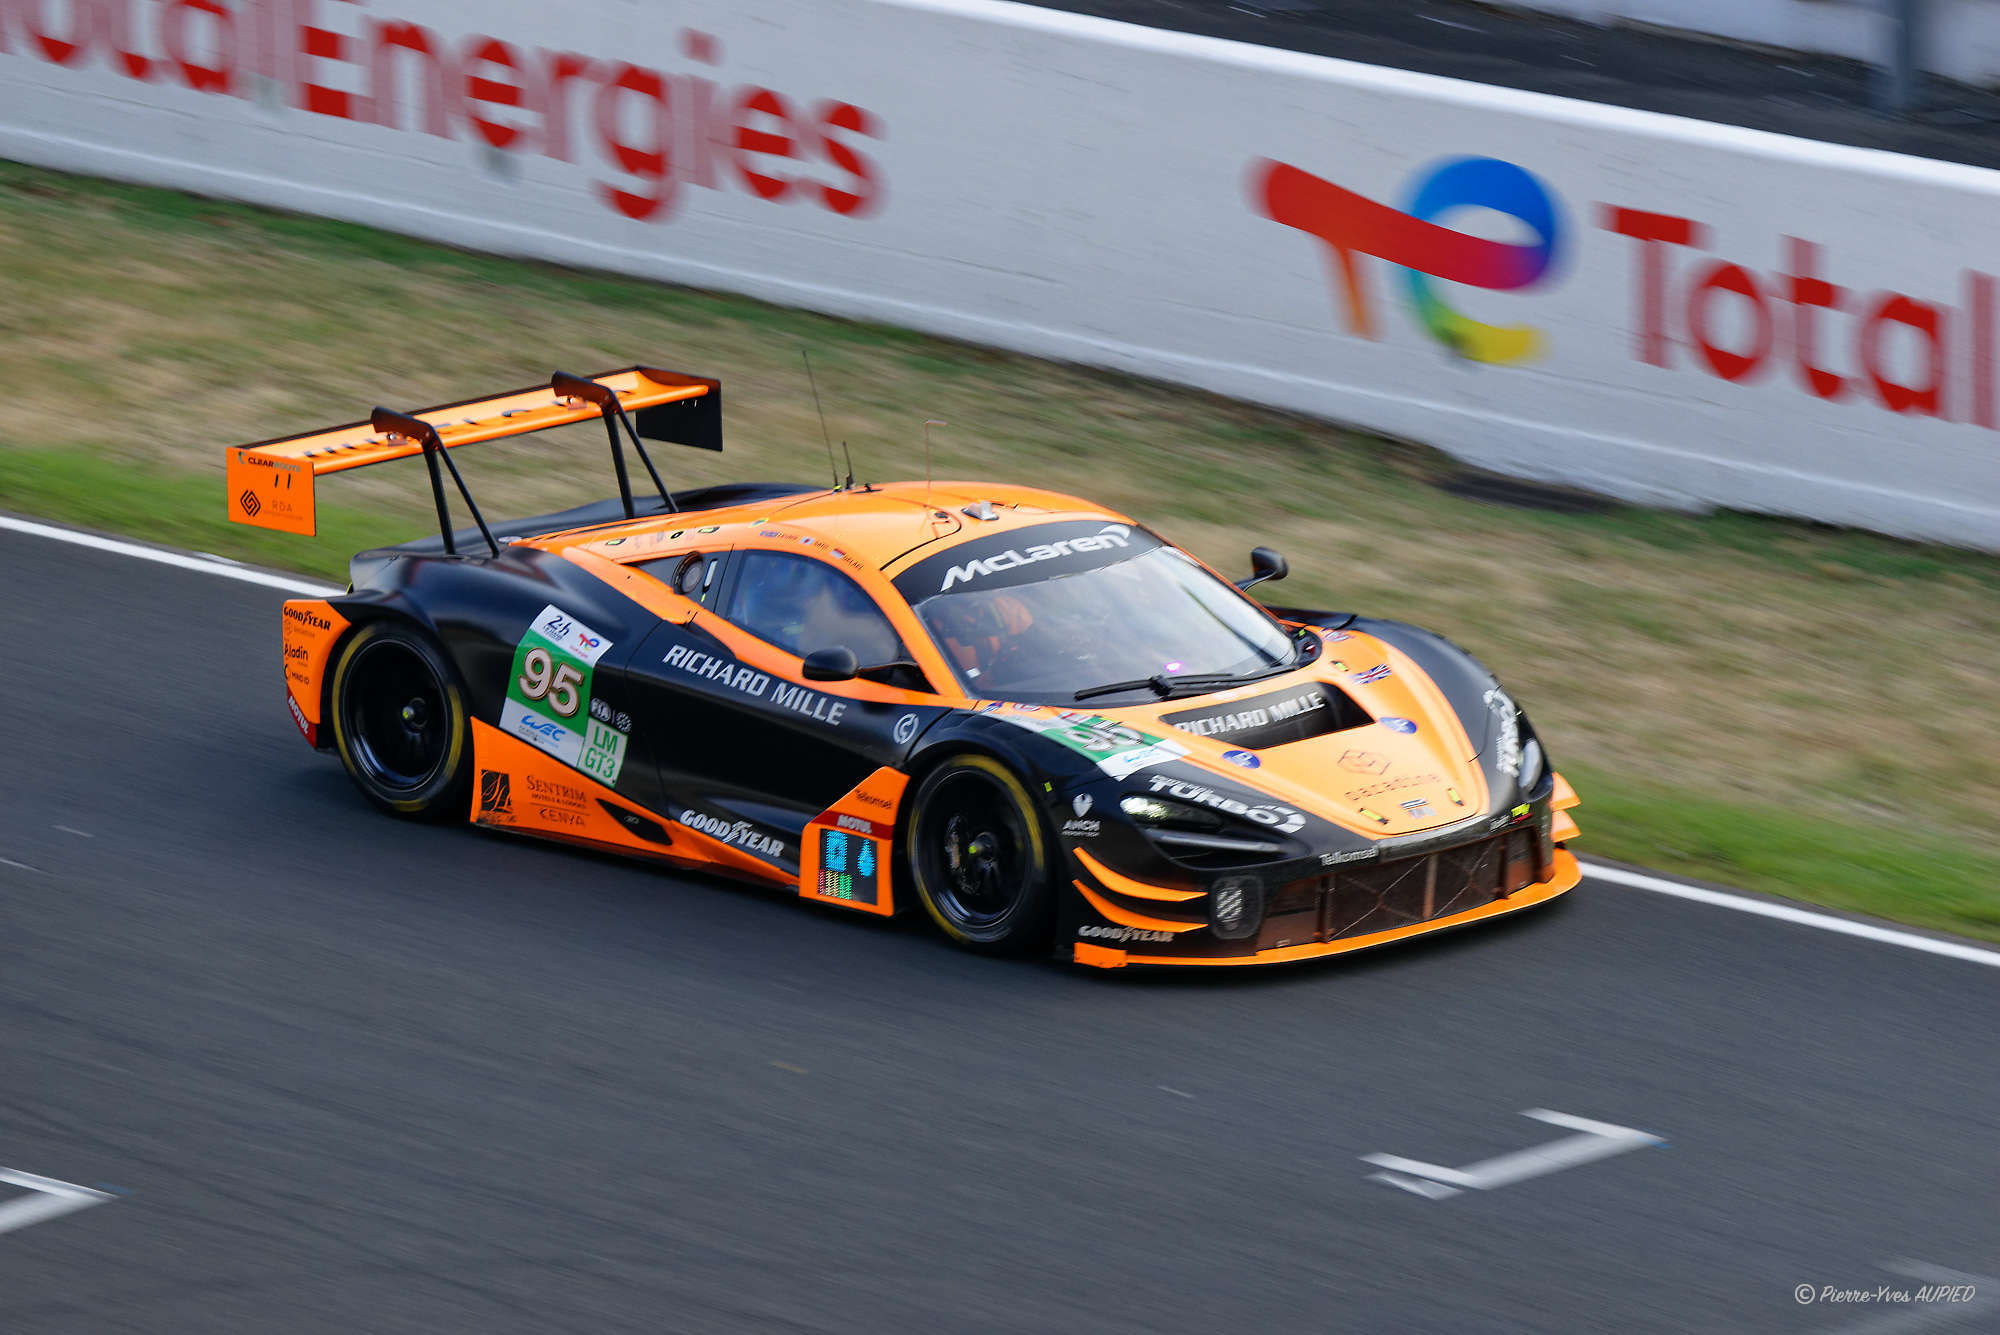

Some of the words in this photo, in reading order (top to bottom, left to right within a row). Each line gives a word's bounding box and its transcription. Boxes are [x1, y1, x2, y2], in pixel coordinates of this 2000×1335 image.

[0, 0, 889, 222] otalEnergies
[940, 527, 1130, 592] McLaren
[283, 606, 331, 631] GOODYEAR
[519, 647, 585, 718] 95
[662, 644, 770, 697] RICHARD
[770, 682, 848, 727] MILLE
[288, 695, 309, 735] MOTUL
[520, 715, 566, 742] WEC
[1173, 708, 1269, 737] RICHARD
[593, 726, 618, 755] LM
[584, 747, 617, 779] GT3
[680, 809, 785, 858] GOODYEAR
[837, 814, 872, 835] MOTUL
[1078, 925, 1175, 943] GOODYEAR
